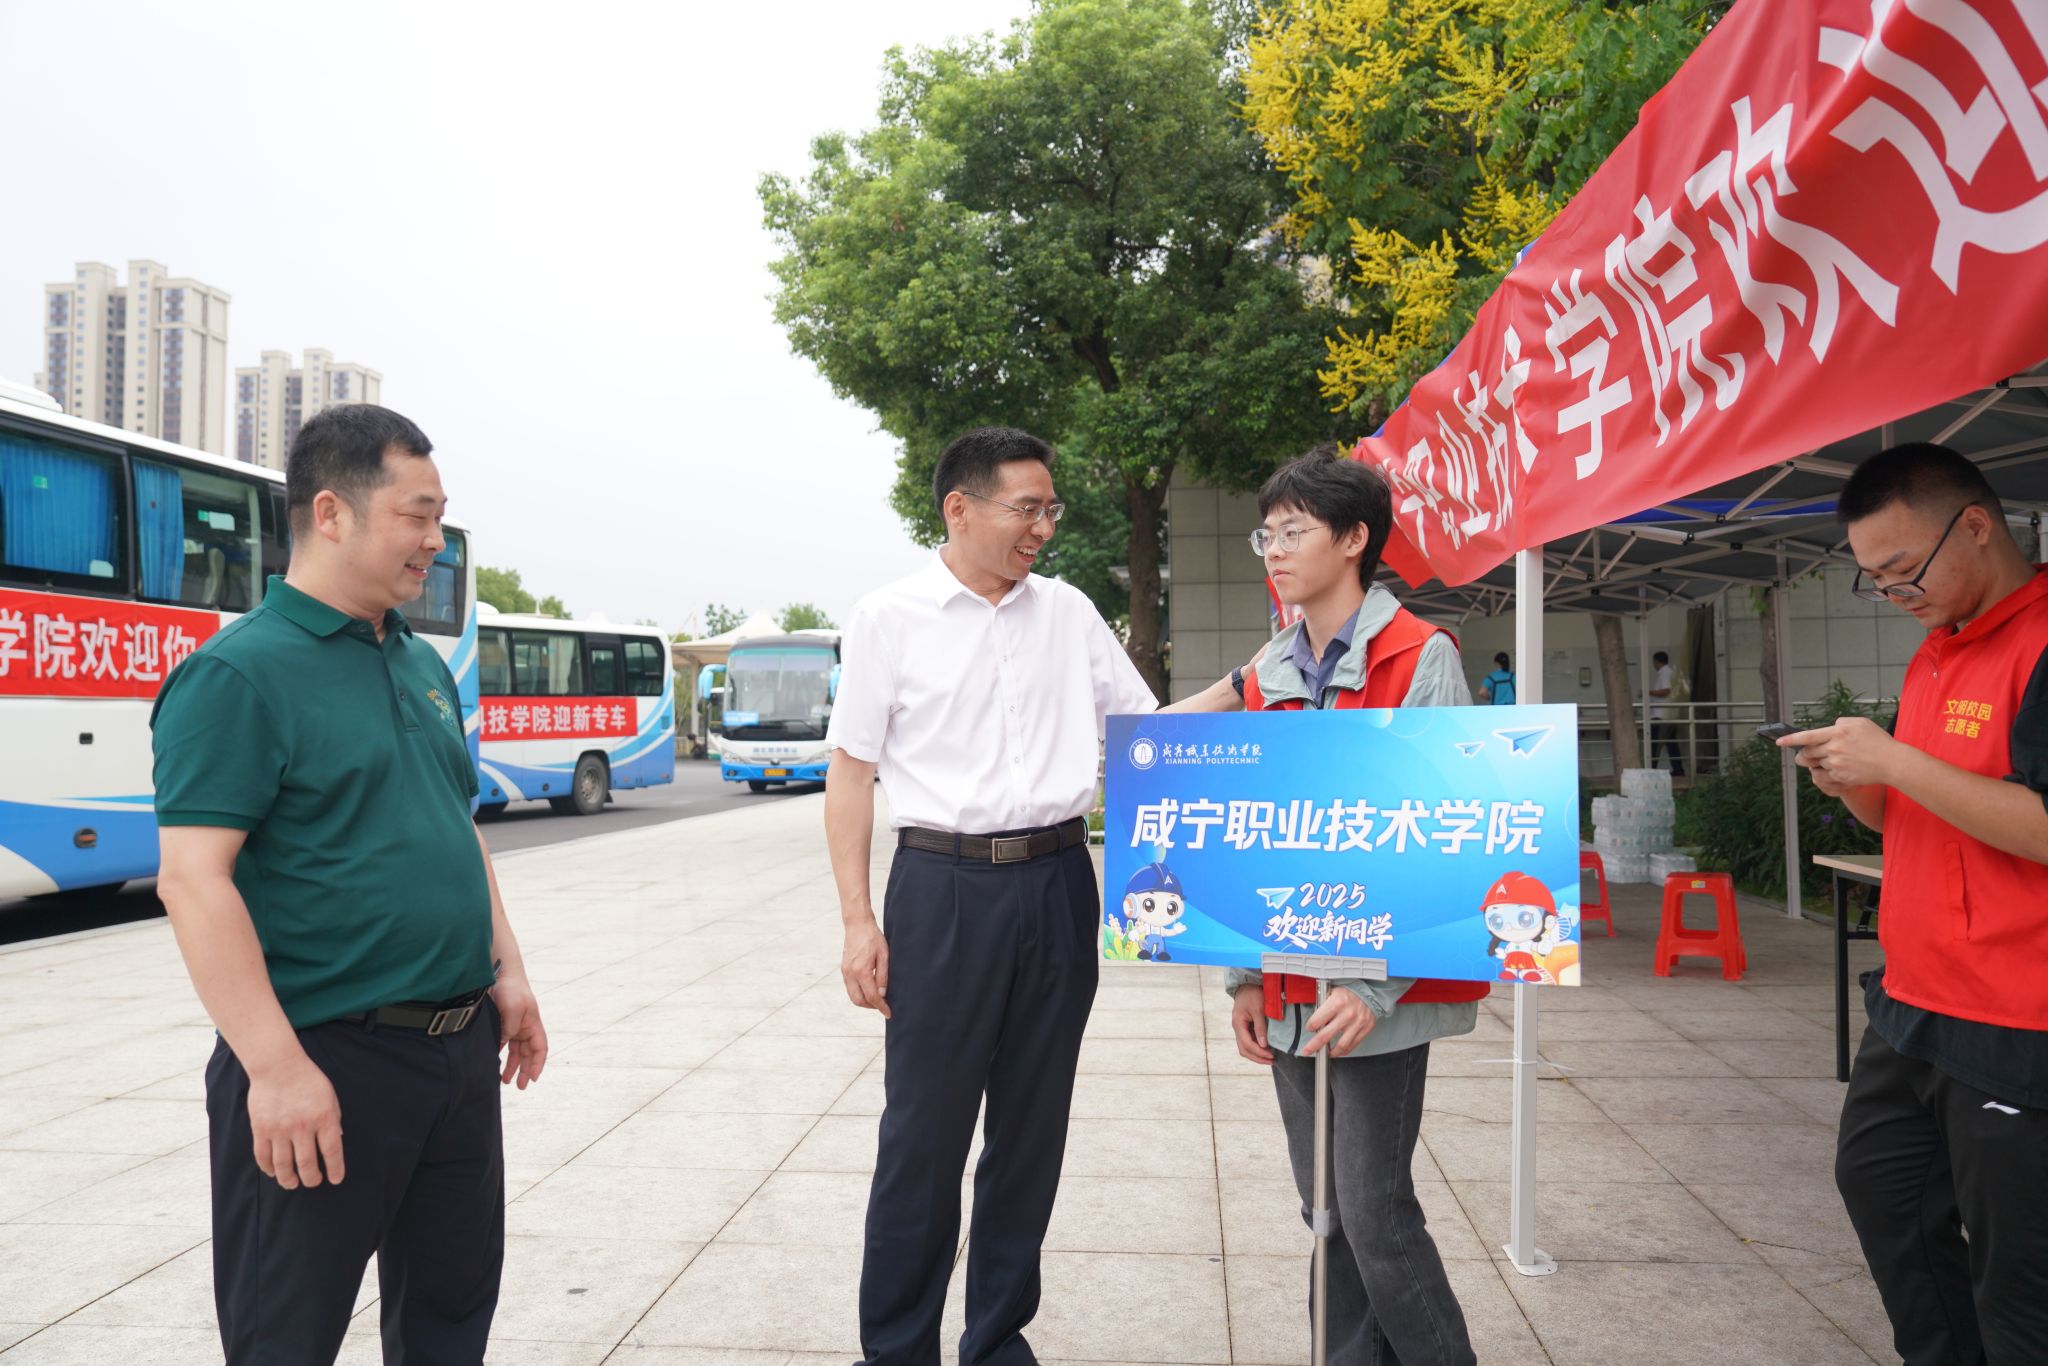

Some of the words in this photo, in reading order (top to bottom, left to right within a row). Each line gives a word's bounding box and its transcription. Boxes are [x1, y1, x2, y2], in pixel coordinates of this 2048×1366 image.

[1943, 699, 1993, 721] 文明校园
[1944, 718, 1981, 738] 志愿者
[1165, 757, 1202, 765] XIANNING
[1206, 757, 1260, 765] POLYTECHNIC
[1130, 798, 1544, 855] 咸宁职业技术学院
[1300, 882, 1366, 909] 2025
[1263, 905, 1393, 954] 欢迎新同学
